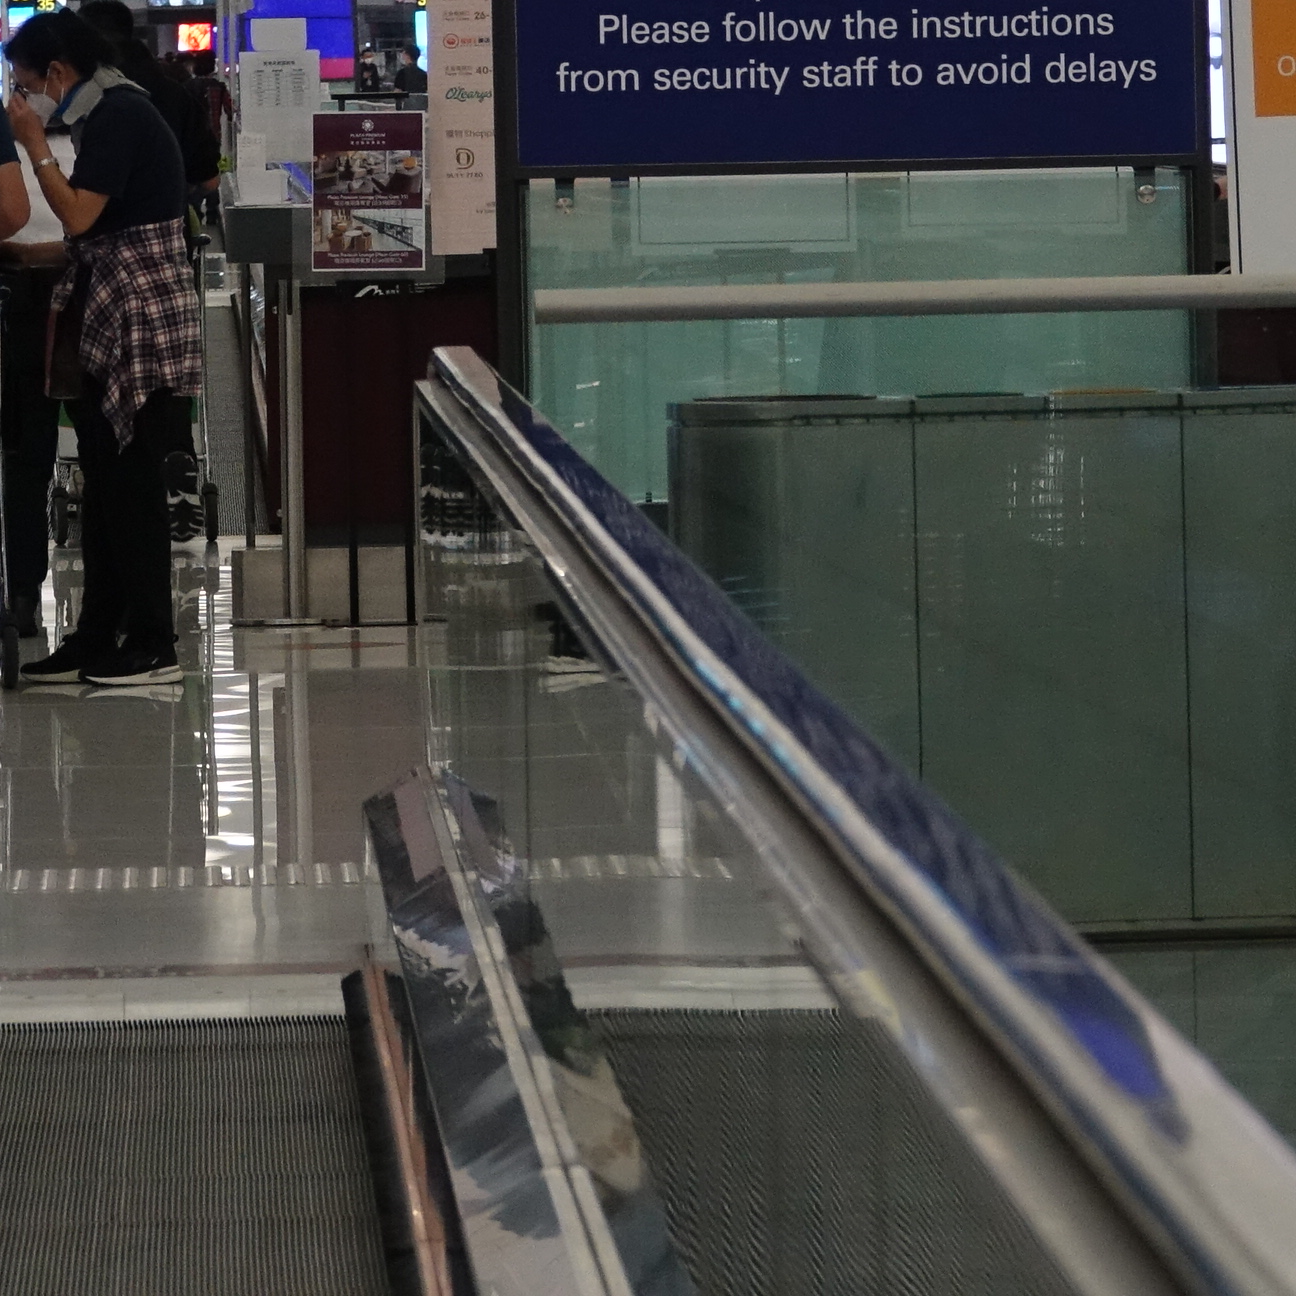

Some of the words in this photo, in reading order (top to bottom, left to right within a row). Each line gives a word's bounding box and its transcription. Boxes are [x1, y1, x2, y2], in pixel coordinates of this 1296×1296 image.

[600, 14, 709, 44] Please
[722, 12, 831, 42] follow
[842, 10, 897, 40] the
[912, 6, 1113, 38] instructions
[556, 62, 639, 92] from
[654, 59, 789, 95] security
[803, 56, 878, 87] staff
[888, 60, 922, 86] to
[937, 54, 1030, 85] avoid
[1045, 53, 1156, 88] delays
